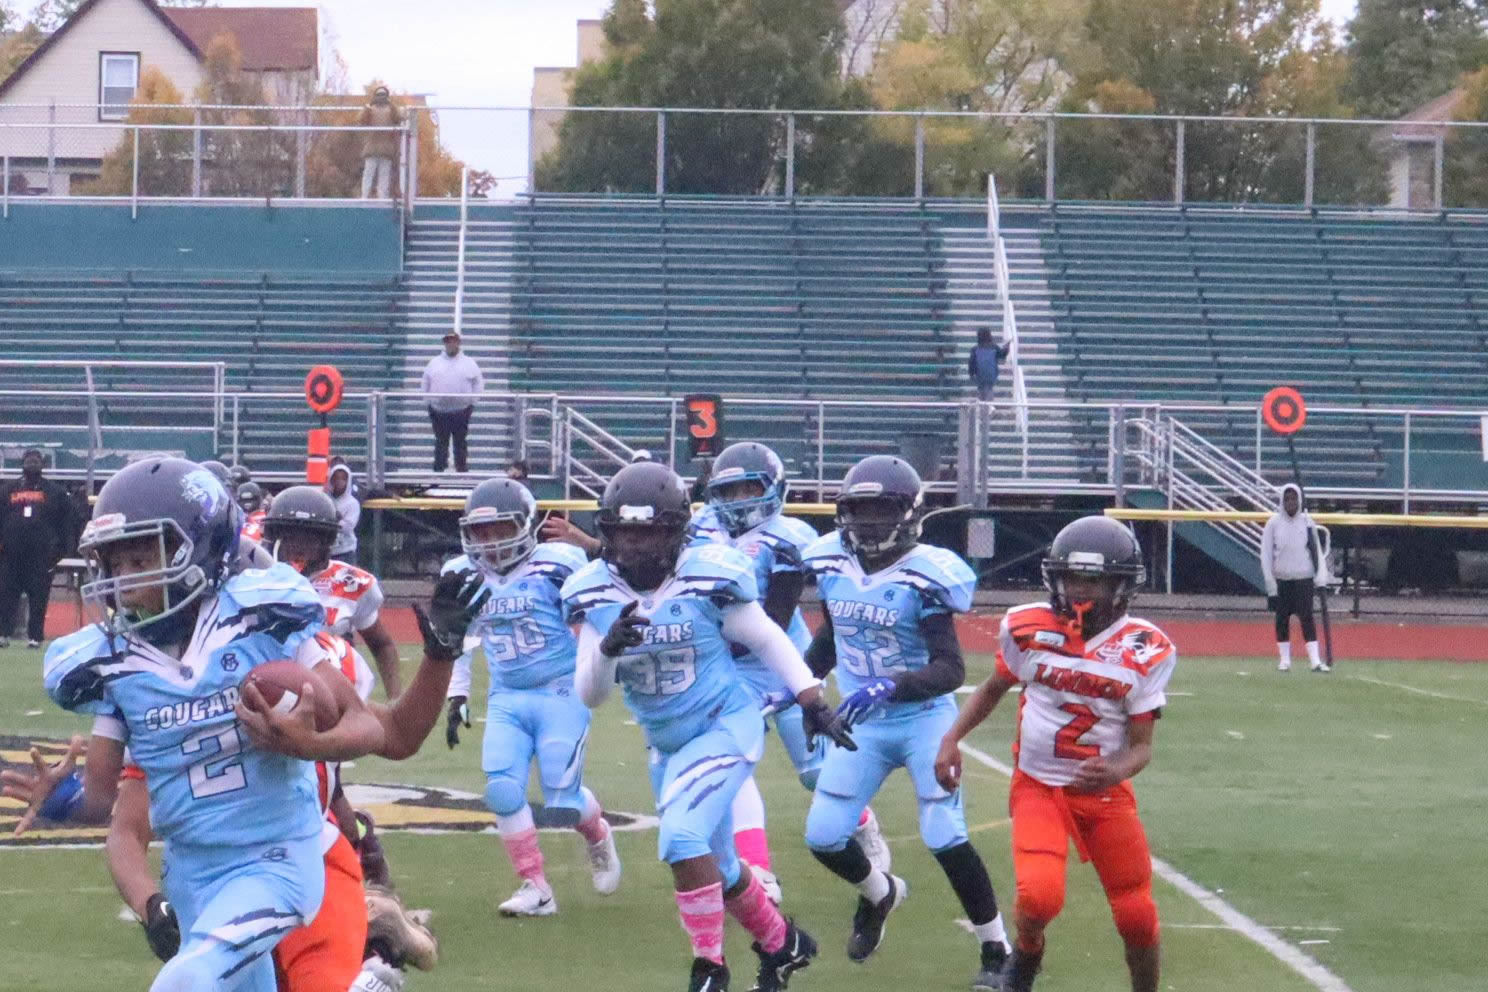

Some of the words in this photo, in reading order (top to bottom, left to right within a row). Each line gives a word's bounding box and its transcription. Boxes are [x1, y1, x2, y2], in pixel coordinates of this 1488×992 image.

[688, 400, 716, 439] 3
[827, 599, 898, 627] COUGARS
[144, 684, 241, 731] COUGAR
[1054, 702, 1100, 761] 2
[180, 725, 248, 801] 2
